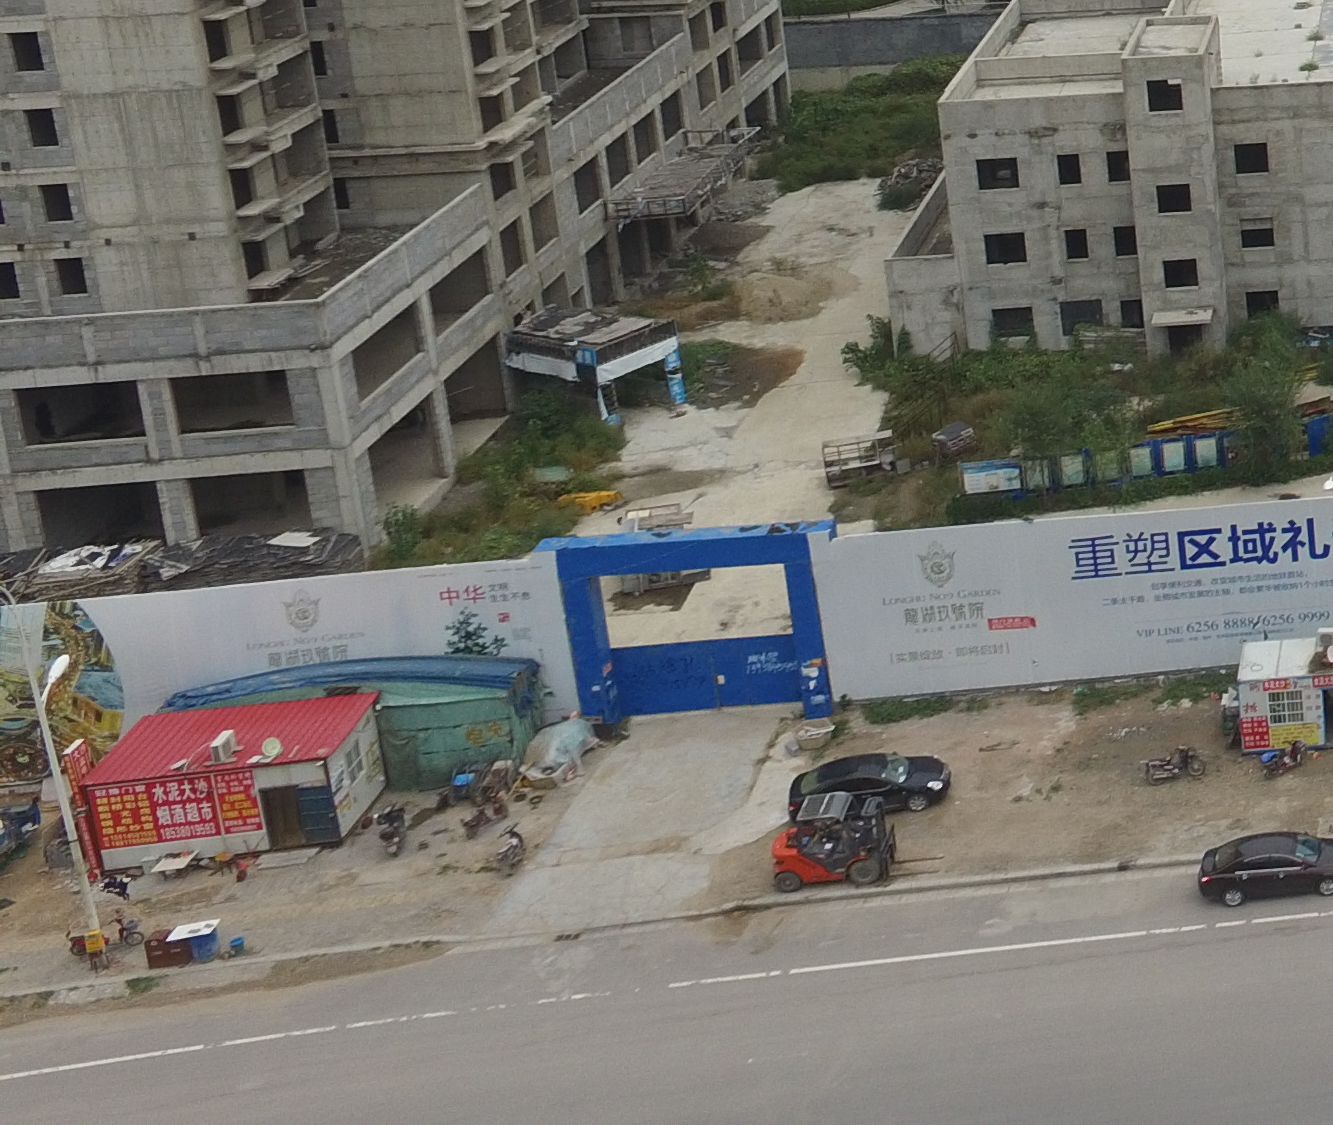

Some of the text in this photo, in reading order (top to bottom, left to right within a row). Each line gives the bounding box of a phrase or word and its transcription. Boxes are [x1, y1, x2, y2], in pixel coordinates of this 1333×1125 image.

[439, 585, 486, 606] 中华
[1136, 627, 1155, 638] VIP
[1157, 625, 1184, 636] LINE
[1186, 619, 1219, 633] 6256
[1298, 610, 1330, 623] 9999
[152, 779, 208, 804] 水泥大沙
[156, 802, 214, 826] 烟酒超市
